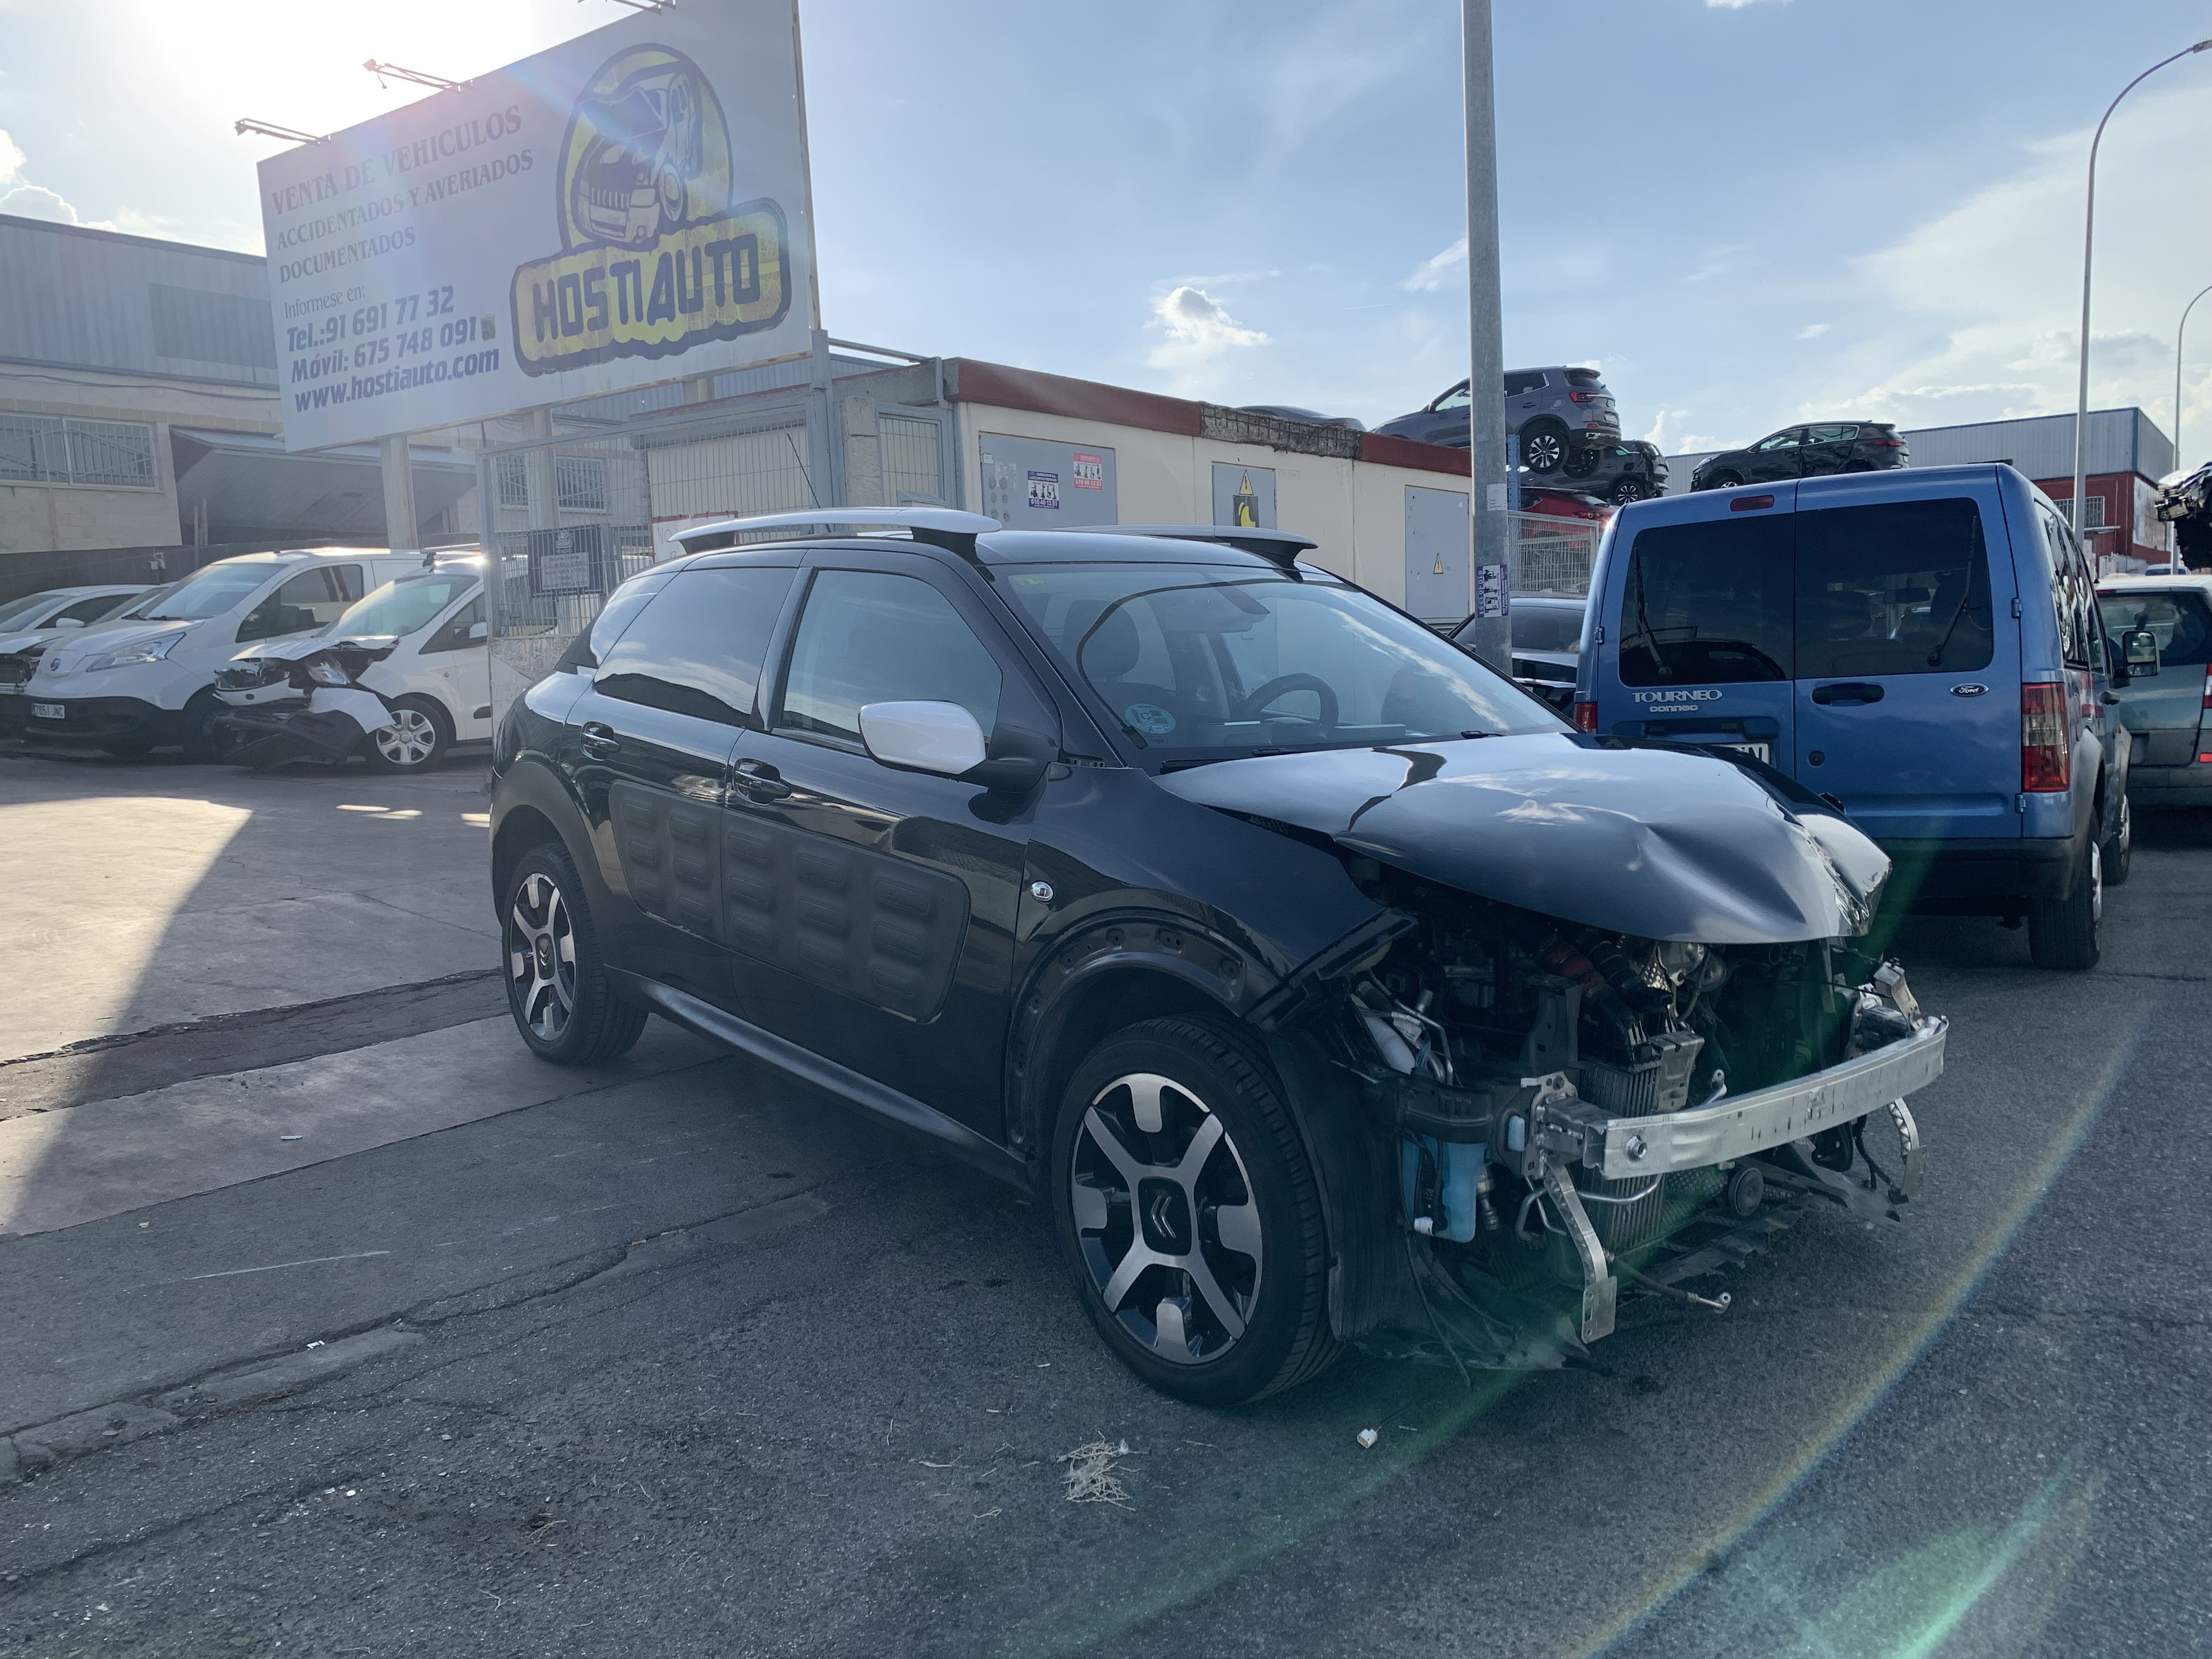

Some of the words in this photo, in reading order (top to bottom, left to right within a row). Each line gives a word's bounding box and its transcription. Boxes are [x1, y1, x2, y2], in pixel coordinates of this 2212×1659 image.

[271, 172, 339, 215] VENTA
[345, 159, 376, 191] DE
[381, 105, 522, 177] VEHICULOS
[276, 193, 405, 251] ACCIDENTADOS
[408, 187, 420, 208] Y
[425, 149, 534, 204] AVERIADOS
[279, 226, 416, 283] DOCUMENTADOS
[284, 289, 344, 319] Informese
[347, 285, 366, 305] en:
[352, 303, 386, 336] 691
[394, 294, 421, 325] 77
[426, 285, 454, 318] 32
[532, 233, 760, 343] HOSTIAUTO
[291, 349, 349, 383] Móvil:
[354, 337, 389, 368] 675
[396, 326, 433, 358] 748
[440, 315, 477, 348] 091
[295, 348, 500, 413] www.hostiauto.com
[1632, 689, 1723, 703] TOURNEO
